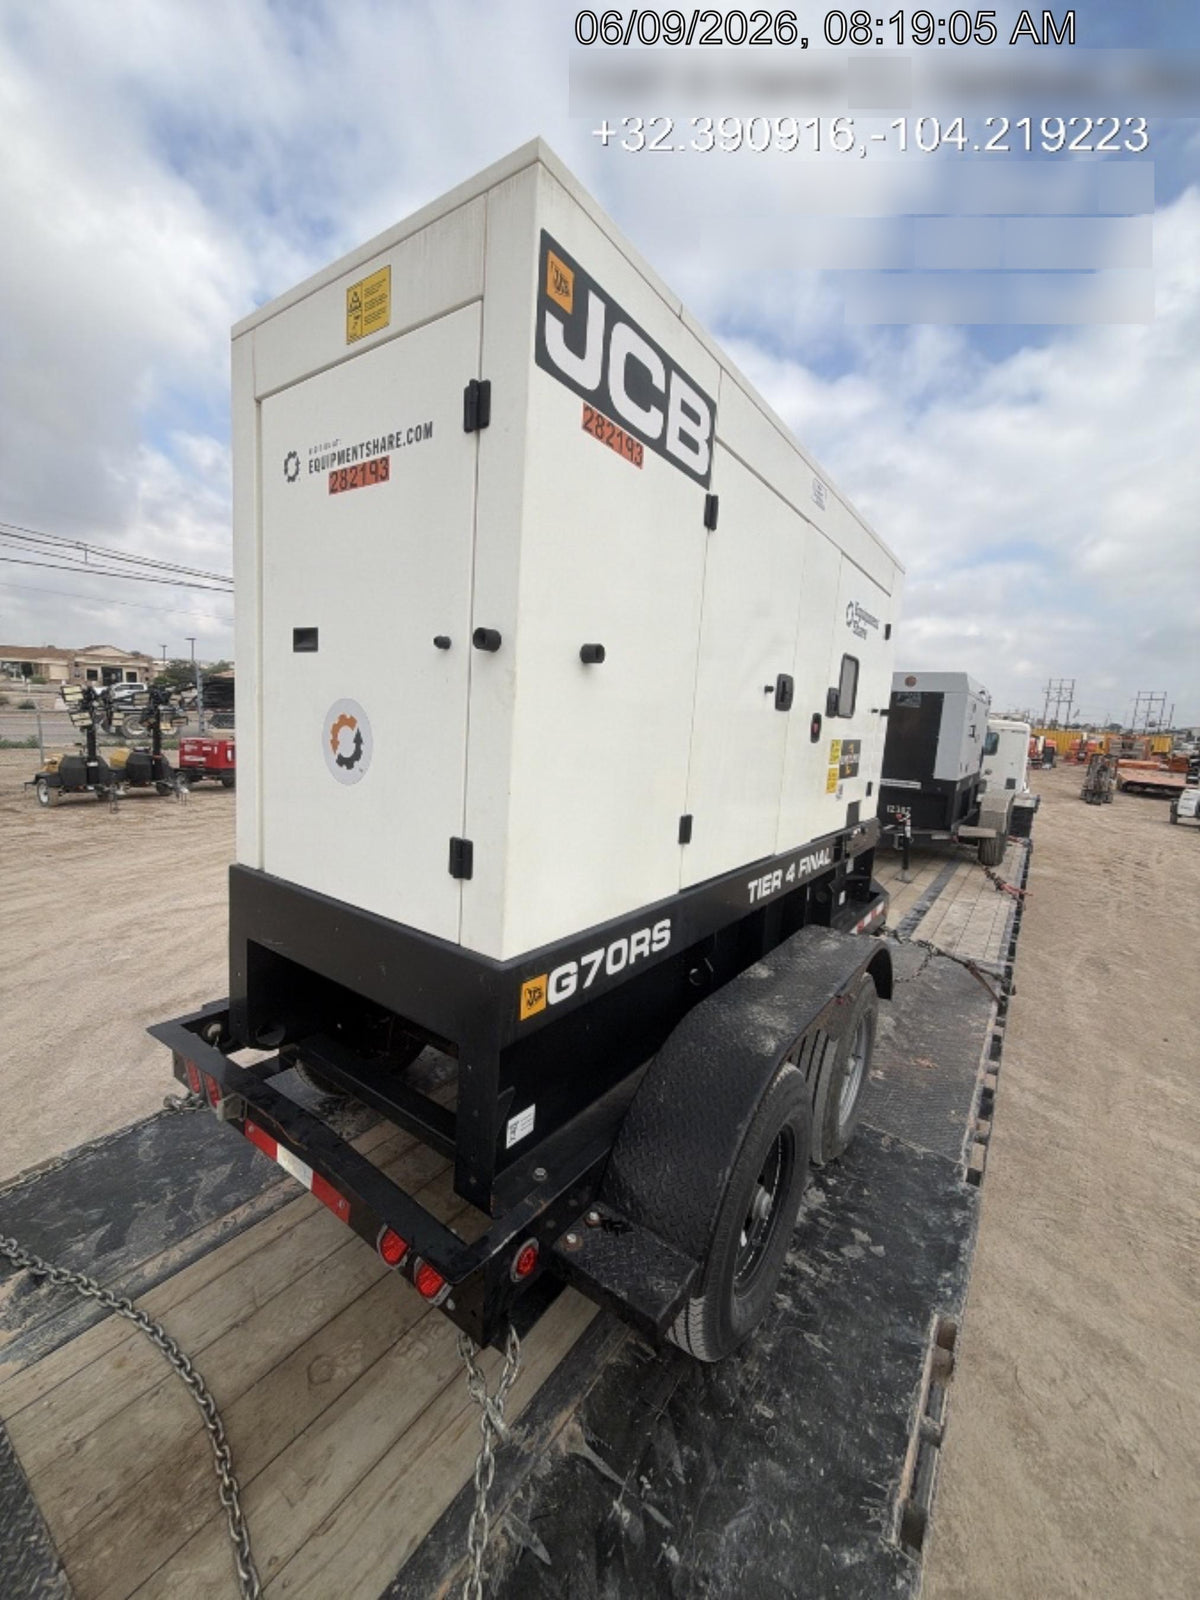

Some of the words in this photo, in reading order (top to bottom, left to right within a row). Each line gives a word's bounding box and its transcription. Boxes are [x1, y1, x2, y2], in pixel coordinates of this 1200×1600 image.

[545, 289, 711, 476] JCB
[308, 421, 433, 474] EQUIPMENTSHARE.COM
[583, 404, 643, 468] 282193
[329, 456, 389, 493] 282193
[748, 869, 783, 904] TIER
[785, 862, 796, 883] 4
[798, 847, 832, 879] FINAL
[547, 918, 671, 1006] G70RS
